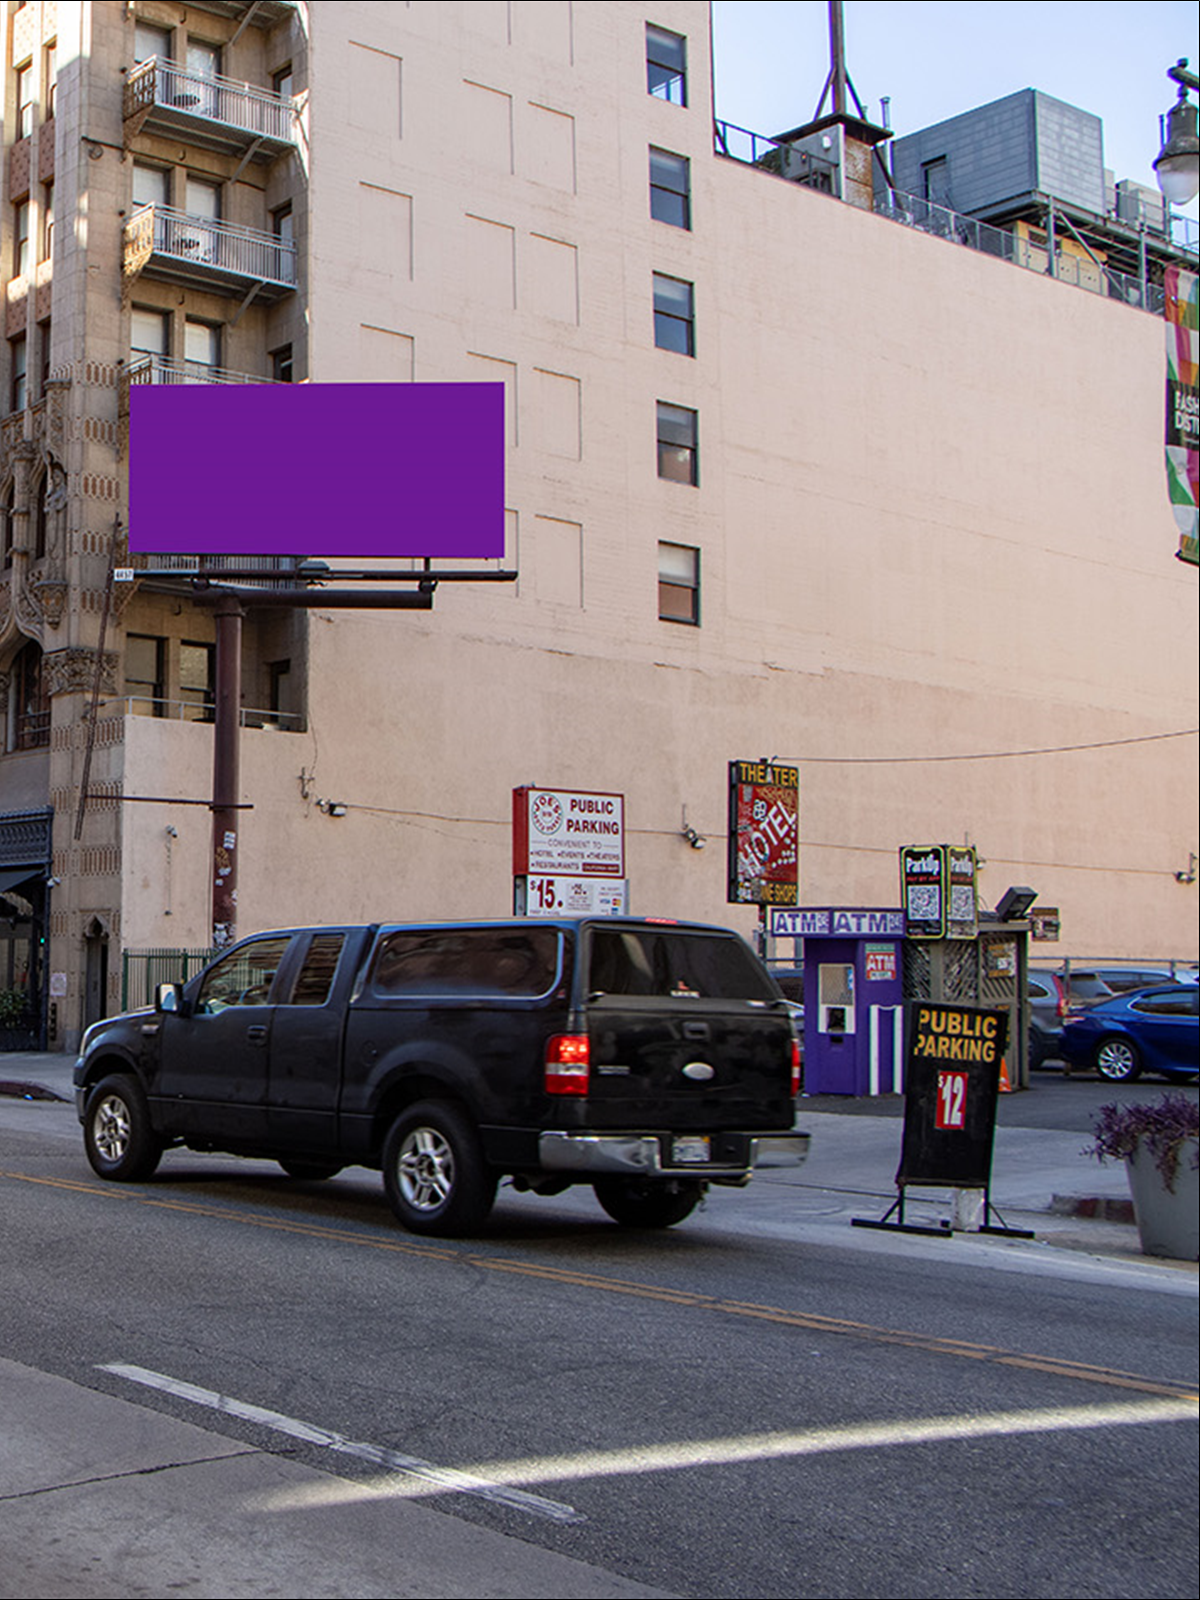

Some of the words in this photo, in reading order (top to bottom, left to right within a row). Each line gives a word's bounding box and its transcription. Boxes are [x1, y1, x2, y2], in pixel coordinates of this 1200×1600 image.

[740, 762, 798, 787] THEATER
[570, 799, 614, 814] PUBLIC
[566, 819, 619, 835] PARKING
[740, 801, 797, 877] HOTEL
[775, 913, 816, 932] ATM
[835, 914, 888, 932] ATM
[867, 954, 896, 970] ATM
[918, 1009, 998, 1038] PUBLIC
[914, 1034, 996, 1062] PARKING
